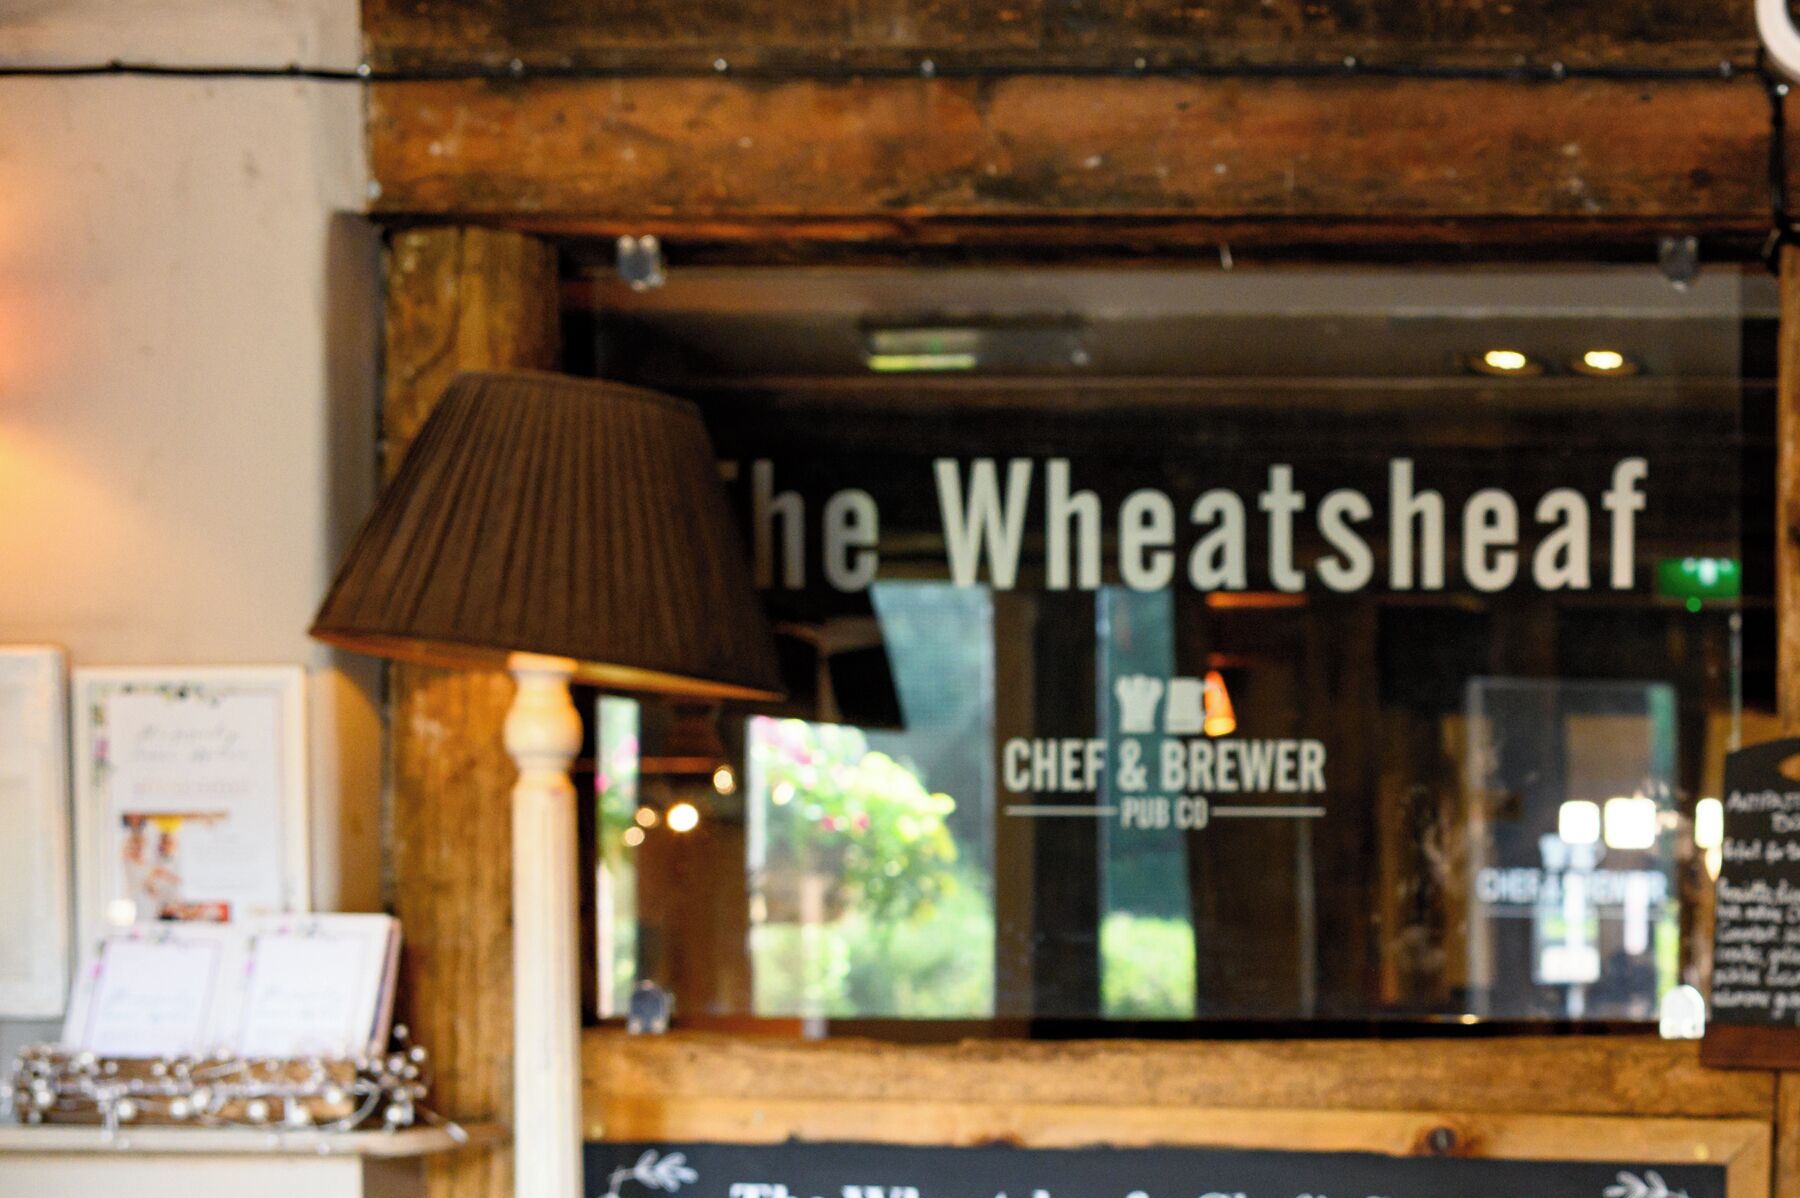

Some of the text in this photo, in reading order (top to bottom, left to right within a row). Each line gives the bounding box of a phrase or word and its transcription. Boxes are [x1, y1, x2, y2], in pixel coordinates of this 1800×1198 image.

[719, 458, 1648, 593] he Wheatsheaf
[1002, 736, 1328, 793] CHEF & BREWER
[1120, 799, 1210, 831] PUB CO
